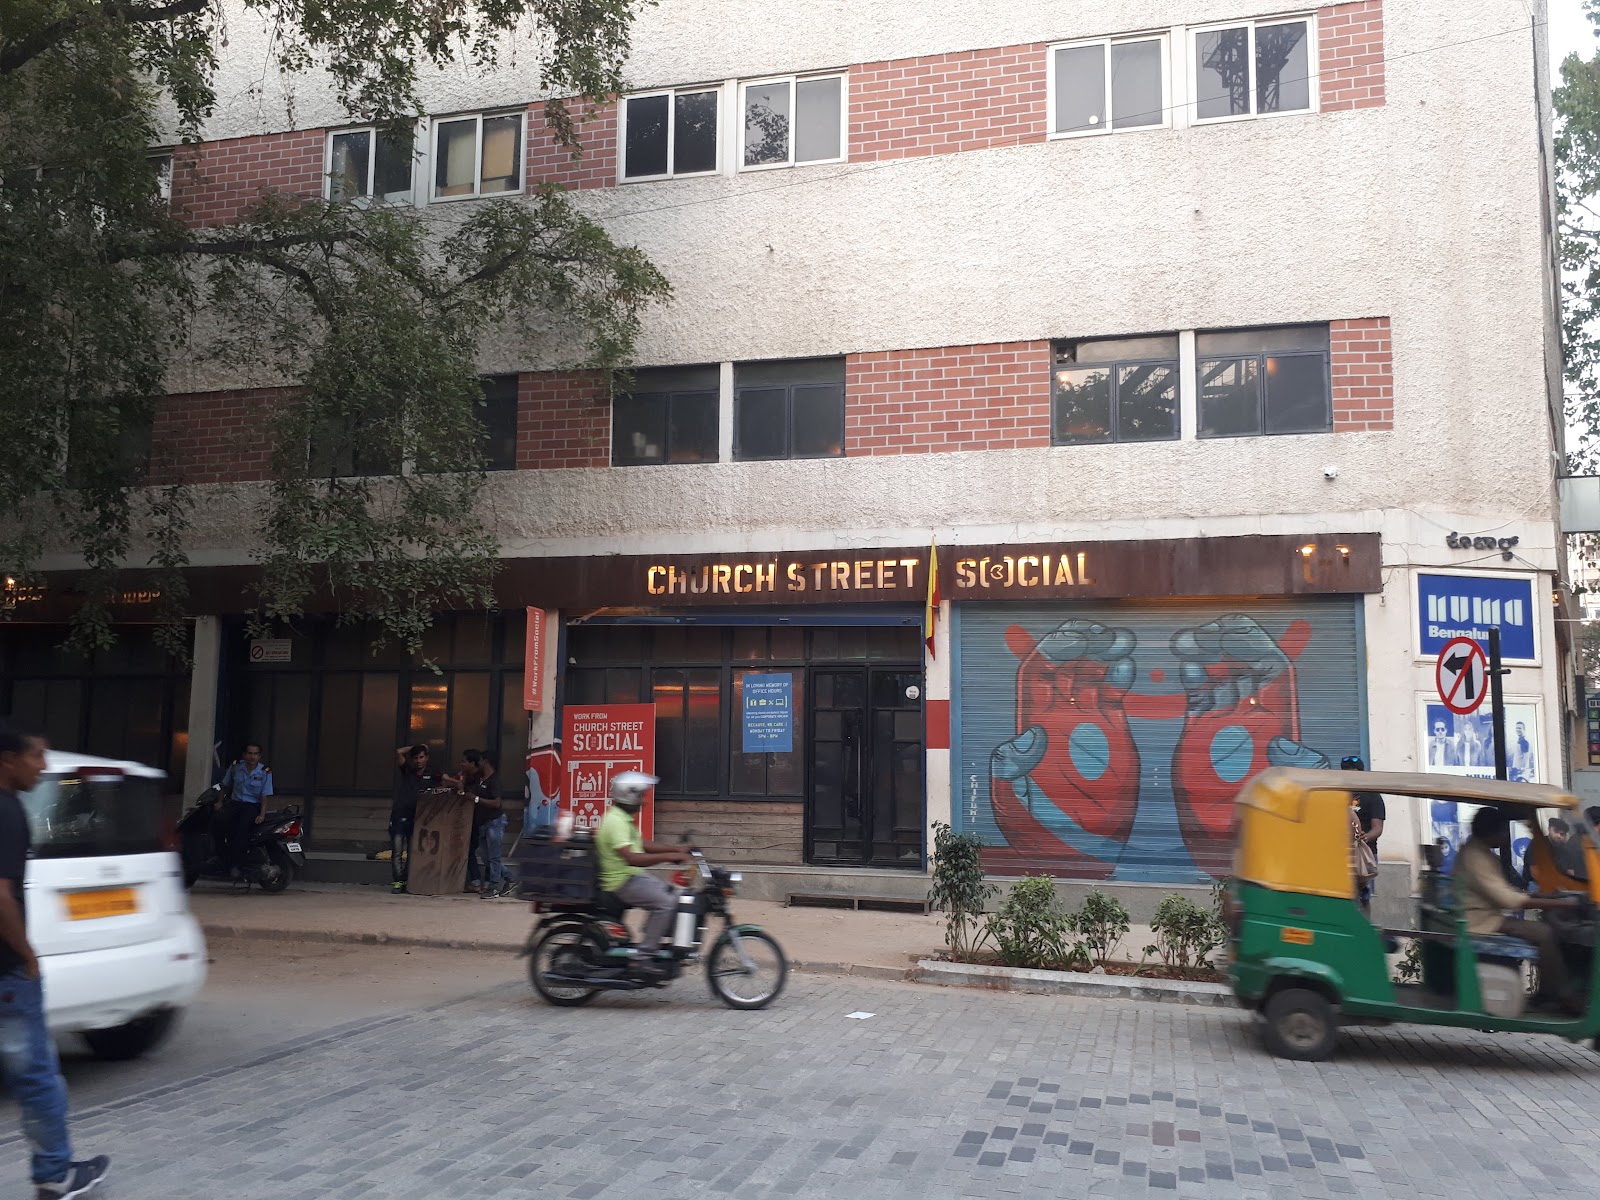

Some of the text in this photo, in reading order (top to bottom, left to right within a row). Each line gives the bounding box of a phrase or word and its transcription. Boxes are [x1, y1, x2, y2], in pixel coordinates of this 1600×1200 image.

[648, 564, 775, 595] CHURCH
[787, 559, 919, 592] STREET
[531, 612, 540, 695] #WorkFromSocial
[573, 721, 644, 732] CHURCH STREET
